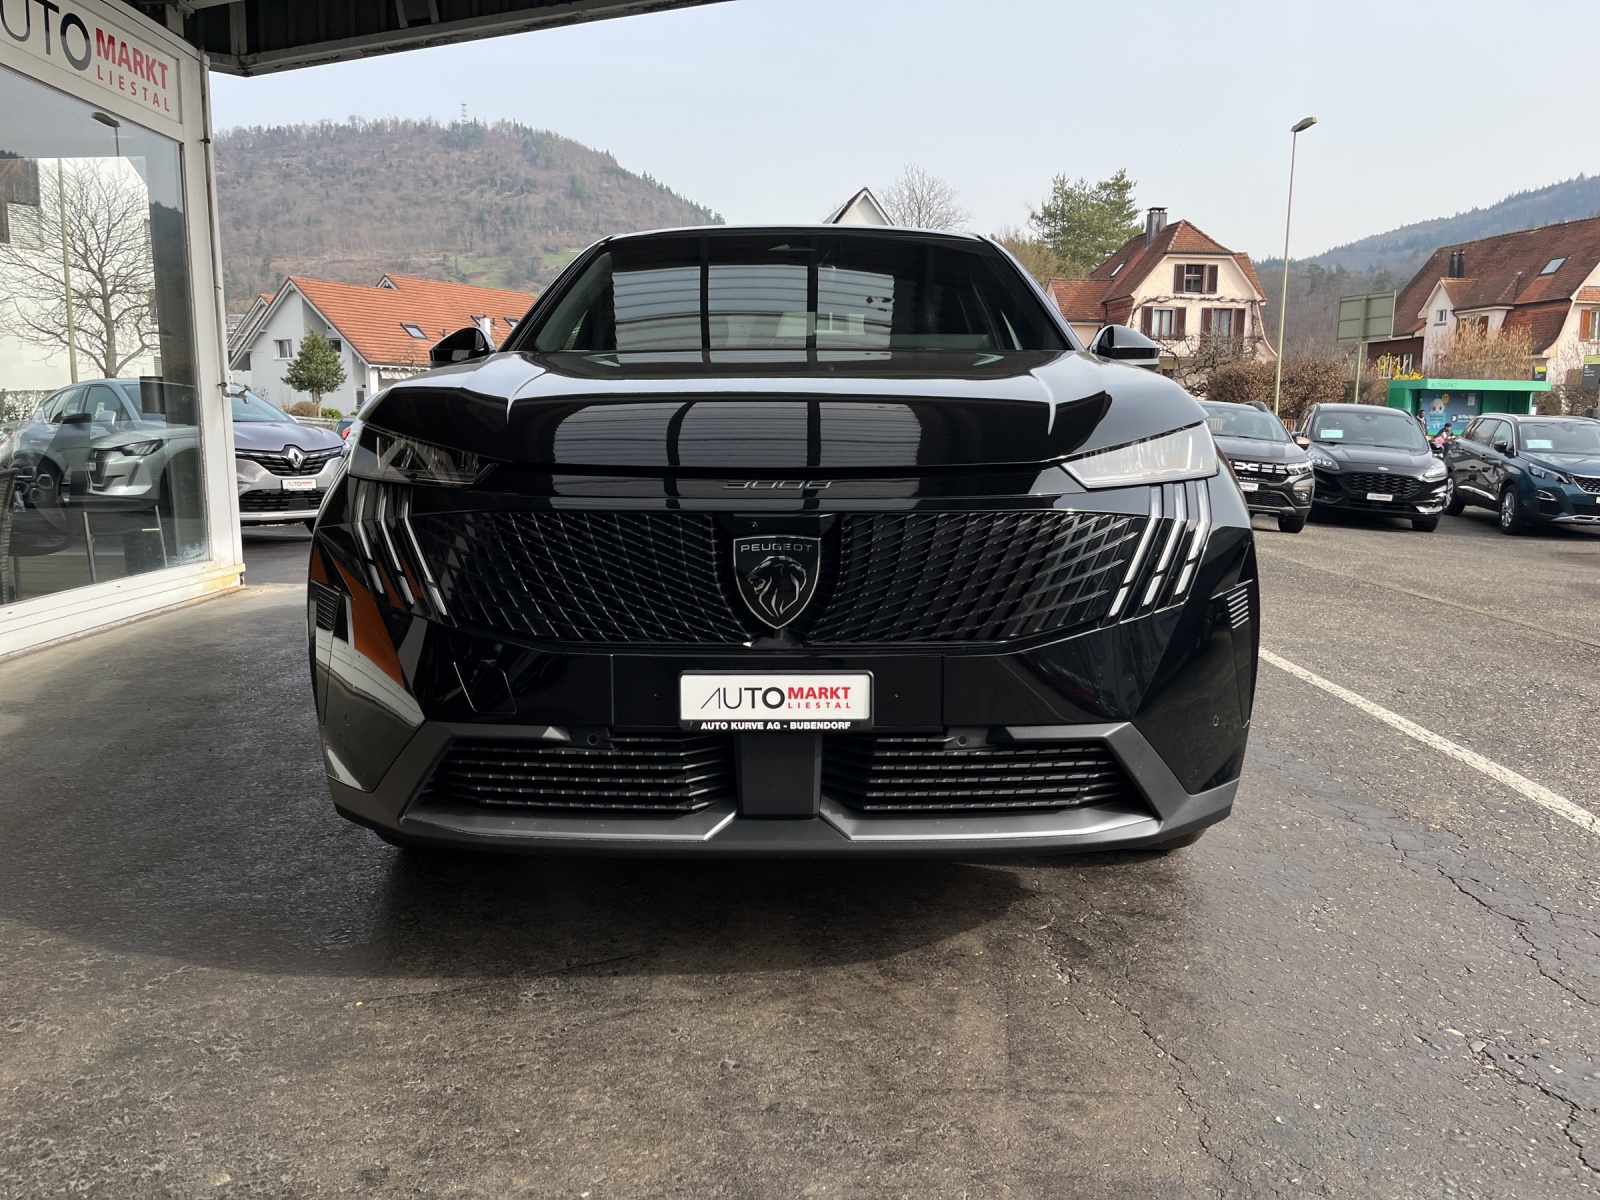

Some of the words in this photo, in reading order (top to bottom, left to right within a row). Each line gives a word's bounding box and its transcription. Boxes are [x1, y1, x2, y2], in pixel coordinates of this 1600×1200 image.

[0, 0, 91, 71] UTO
[96, 28, 168, 89] MARKT
[97, 65, 170, 112] LIESTAL
[740, 543, 813, 552] PEUGEOT
[700, 687, 785, 709] AUTO
[788, 687, 851, 699] MARKT
[701, 722, 728, 730] AUTO
[731, 722, 764, 730] KURVE
[767, 722, 781, 730] AG
[790, 722, 851, 730] BUBENDORF
